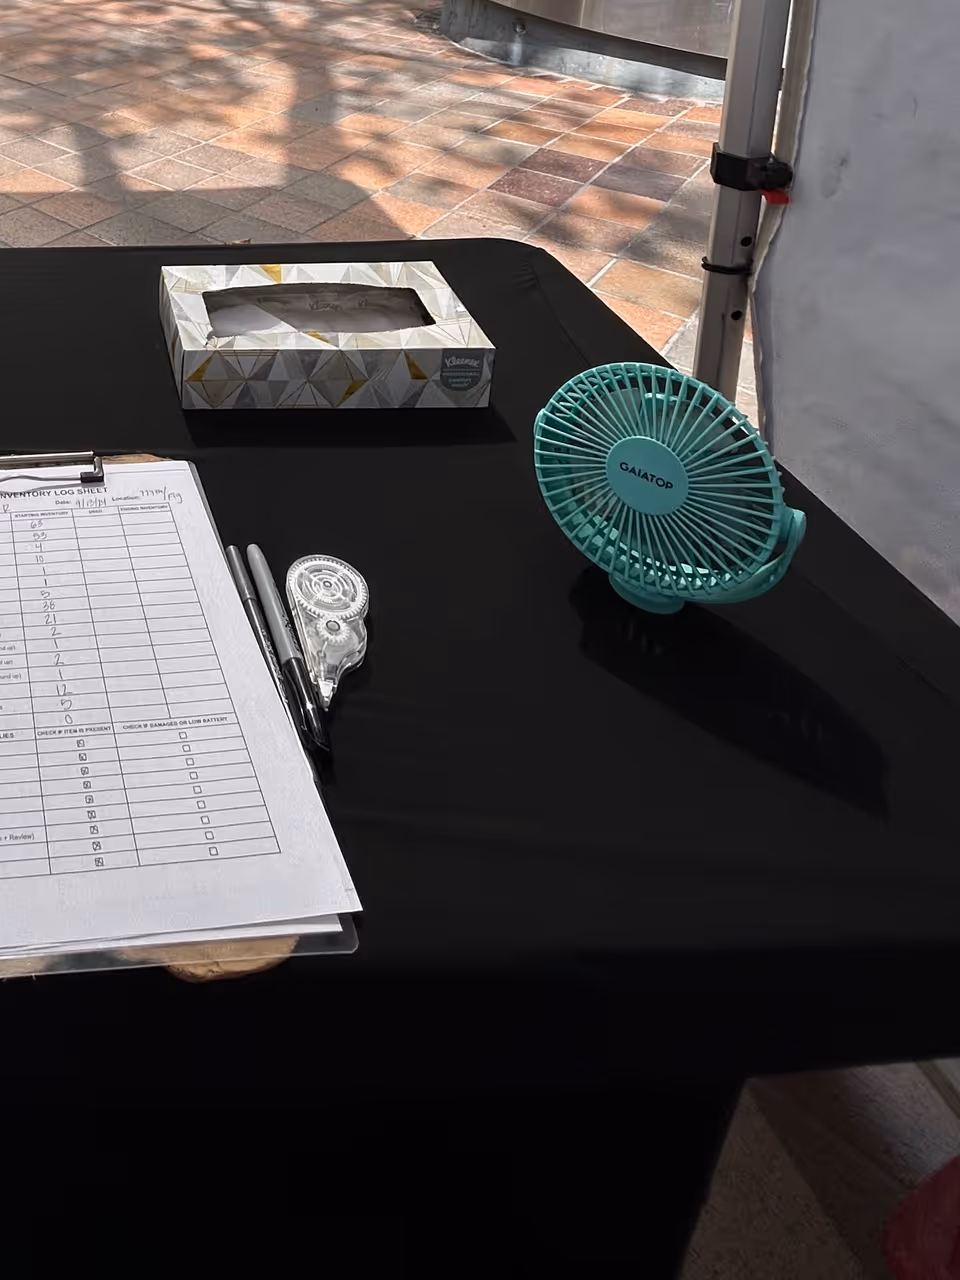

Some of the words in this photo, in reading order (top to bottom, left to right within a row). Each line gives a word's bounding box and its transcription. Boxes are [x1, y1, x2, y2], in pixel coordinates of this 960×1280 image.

[619, 461, 674, 490] GAIATOP
[51, 626, 62, 636] 2
[54, 653, 65, 665] 2
[9, 832, 35, 840] Review)
